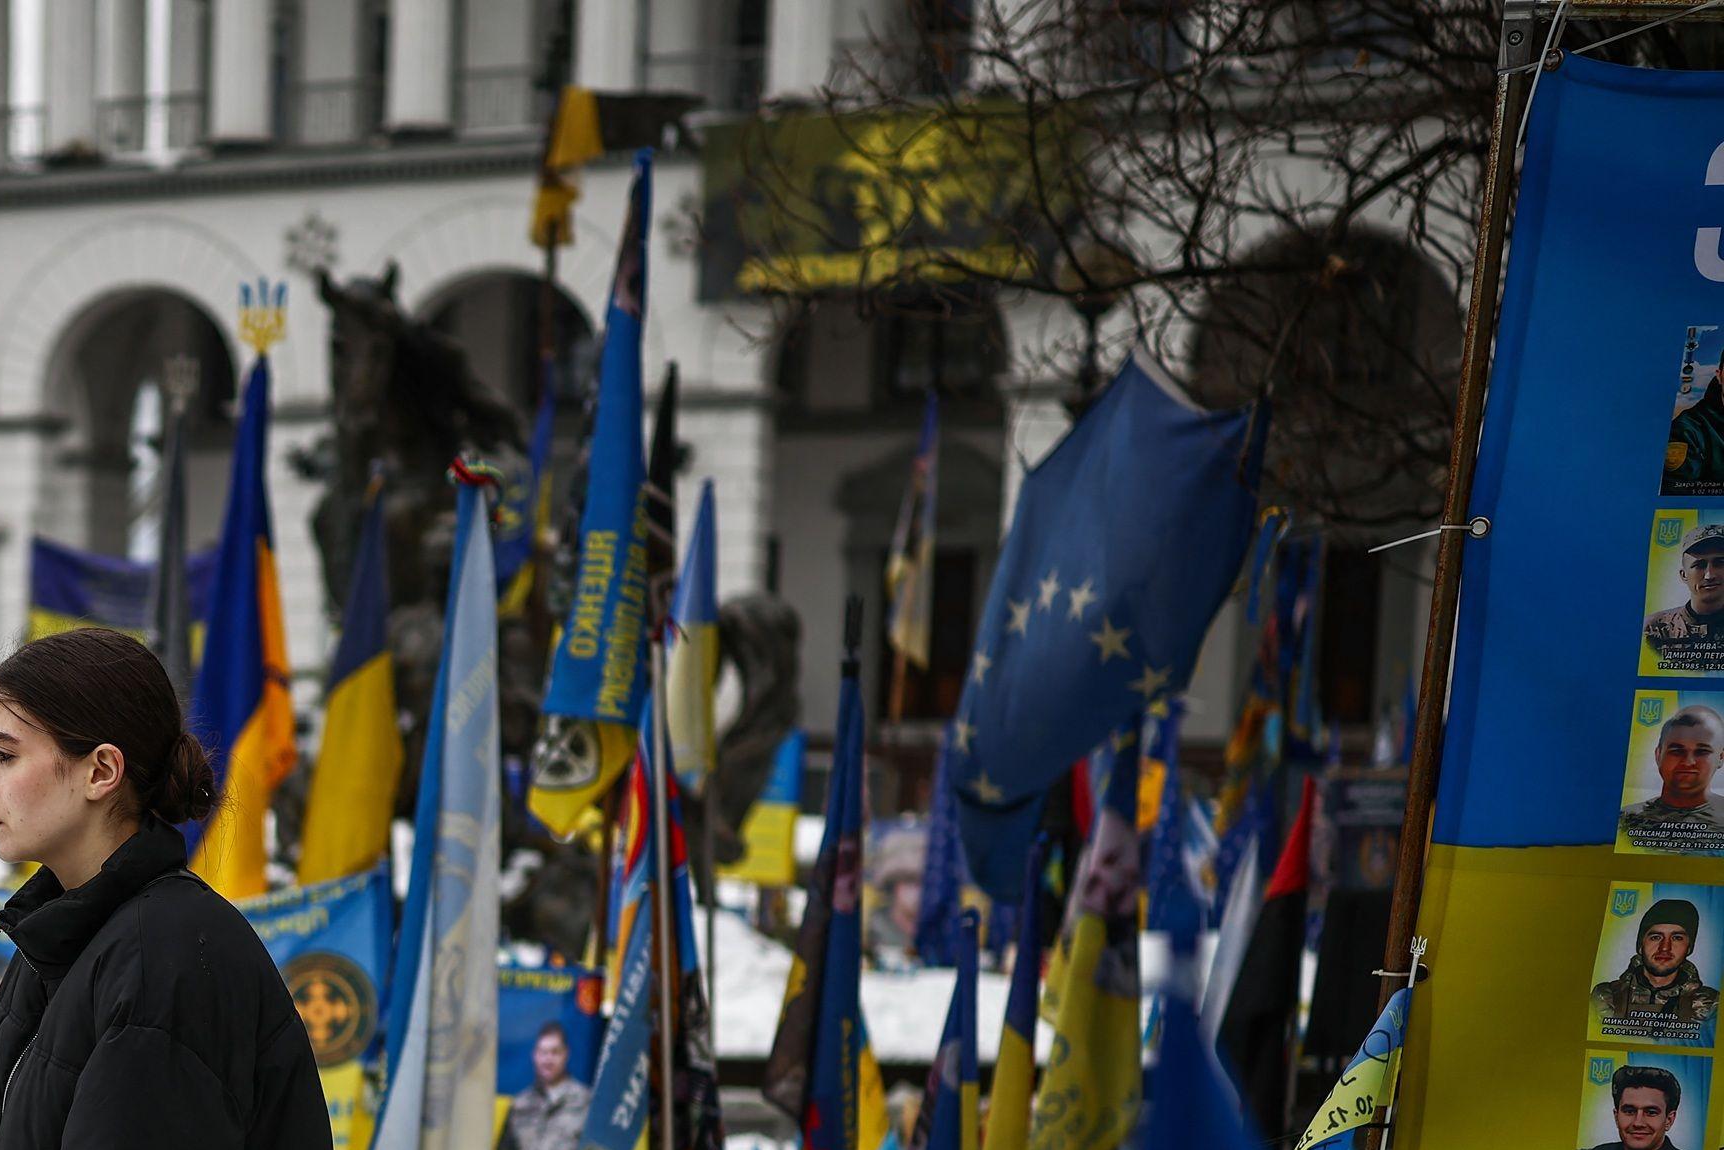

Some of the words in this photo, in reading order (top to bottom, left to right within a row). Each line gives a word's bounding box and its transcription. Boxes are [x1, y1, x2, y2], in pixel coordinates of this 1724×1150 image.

[1693, 642, 1717, 651] КИВА
[1665, 651, 1702, 661] ДМИТРО
[1658, 661, 1700, 670] 19.12.1985
[1659, 821, 1707, 830] ЛИСЕНКО
[1628, 829, 1671, 839] ОЛЕКСАНДР
[1630, 1010, 1679, 1020] ПЛОХАНЬ
[1603, 1017, 1640, 1027] МИКОЛА
[1642, 1019, 1701, 1030] ЛЕОНІДОВИЧ
